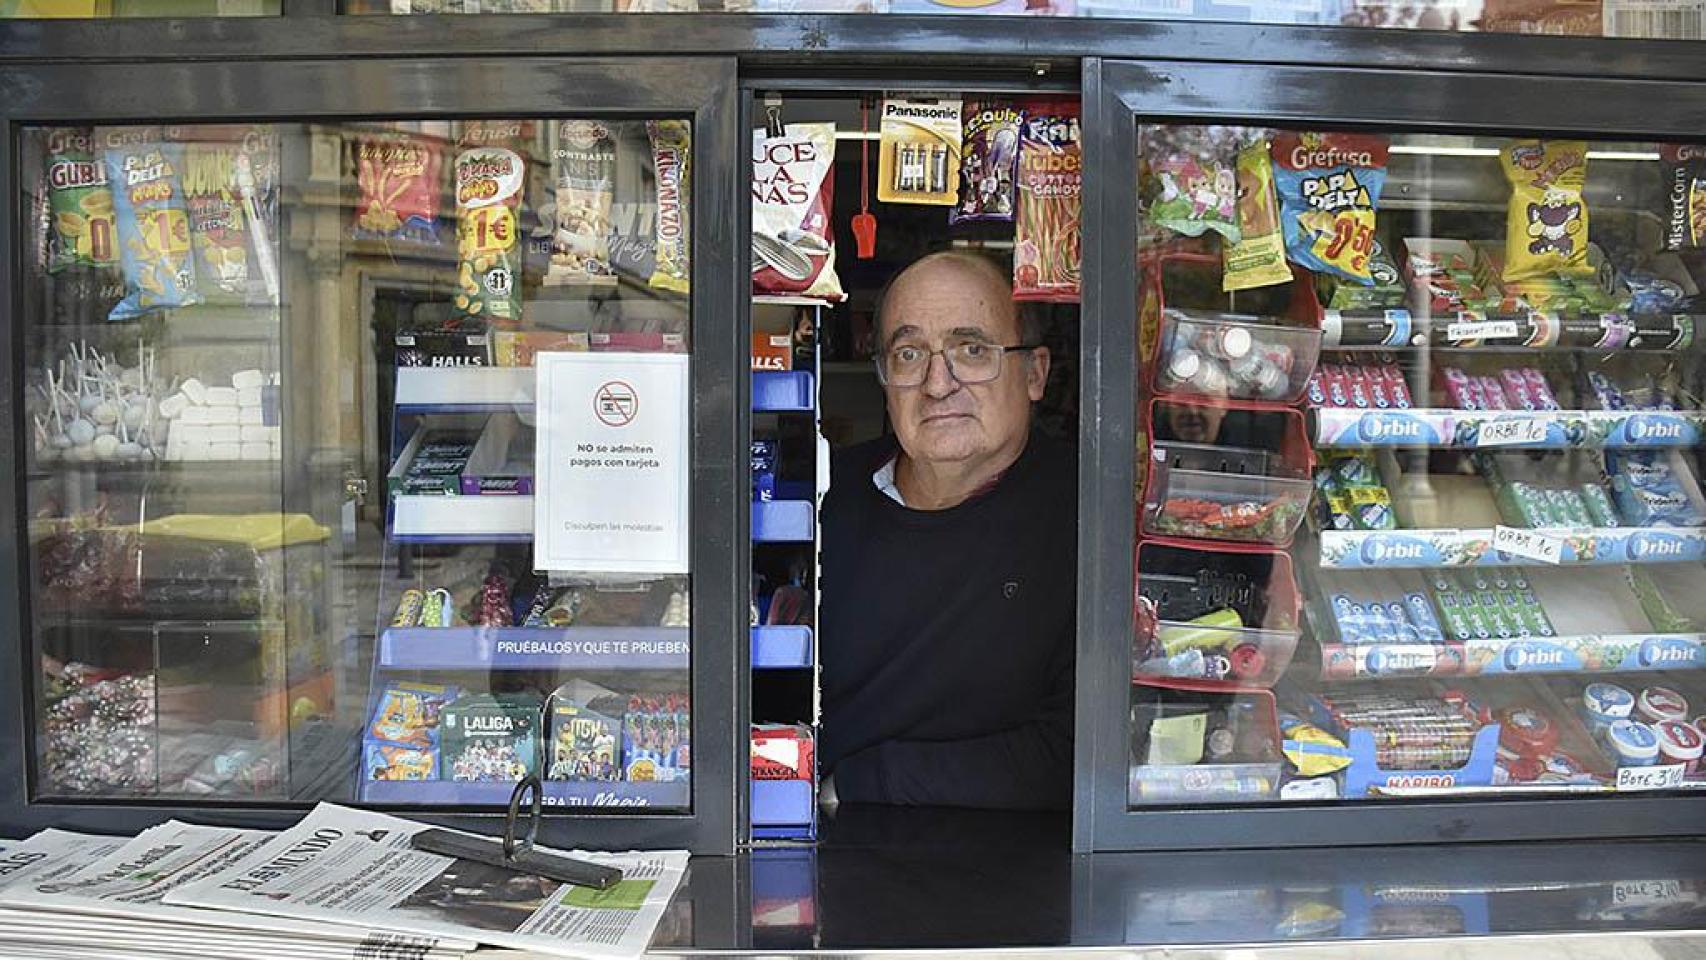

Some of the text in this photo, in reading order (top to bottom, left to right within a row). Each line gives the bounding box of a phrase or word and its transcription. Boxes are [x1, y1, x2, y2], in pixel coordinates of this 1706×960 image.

[886, 104, 958, 120] Panasonic
[1290, 146, 1372, 169] Grefusa
[1667, 168, 1686, 251] MisterCorn
[474, 208, 512, 250] 1€
[432, 355, 482, 368] HALLS
[1358, 412, 1421, 442] Orbit
[1625, 414, 1682, 443] Orbit
[577, 443, 654, 454] NO se admiten
[570, 458, 660, 469] pagos con tarjeta
[565, 521, 664, 532] Disculpen las molestias
[1361, 534, 1424, 565] Orbit
[1626, 532, 1682, 561] Orbit
[497, 639, 572, 654] PRUÉBALOS
[583, 641, 612, 656] QUE
[613, 641, 628, 654] TE
[632, 641, 690, 654] PRUEBEN
[1504, 640, 1564, 671] Orbit
[1639, 638, 1696, 667] Orbit
[464, 716, 514, 731] LALIGA
